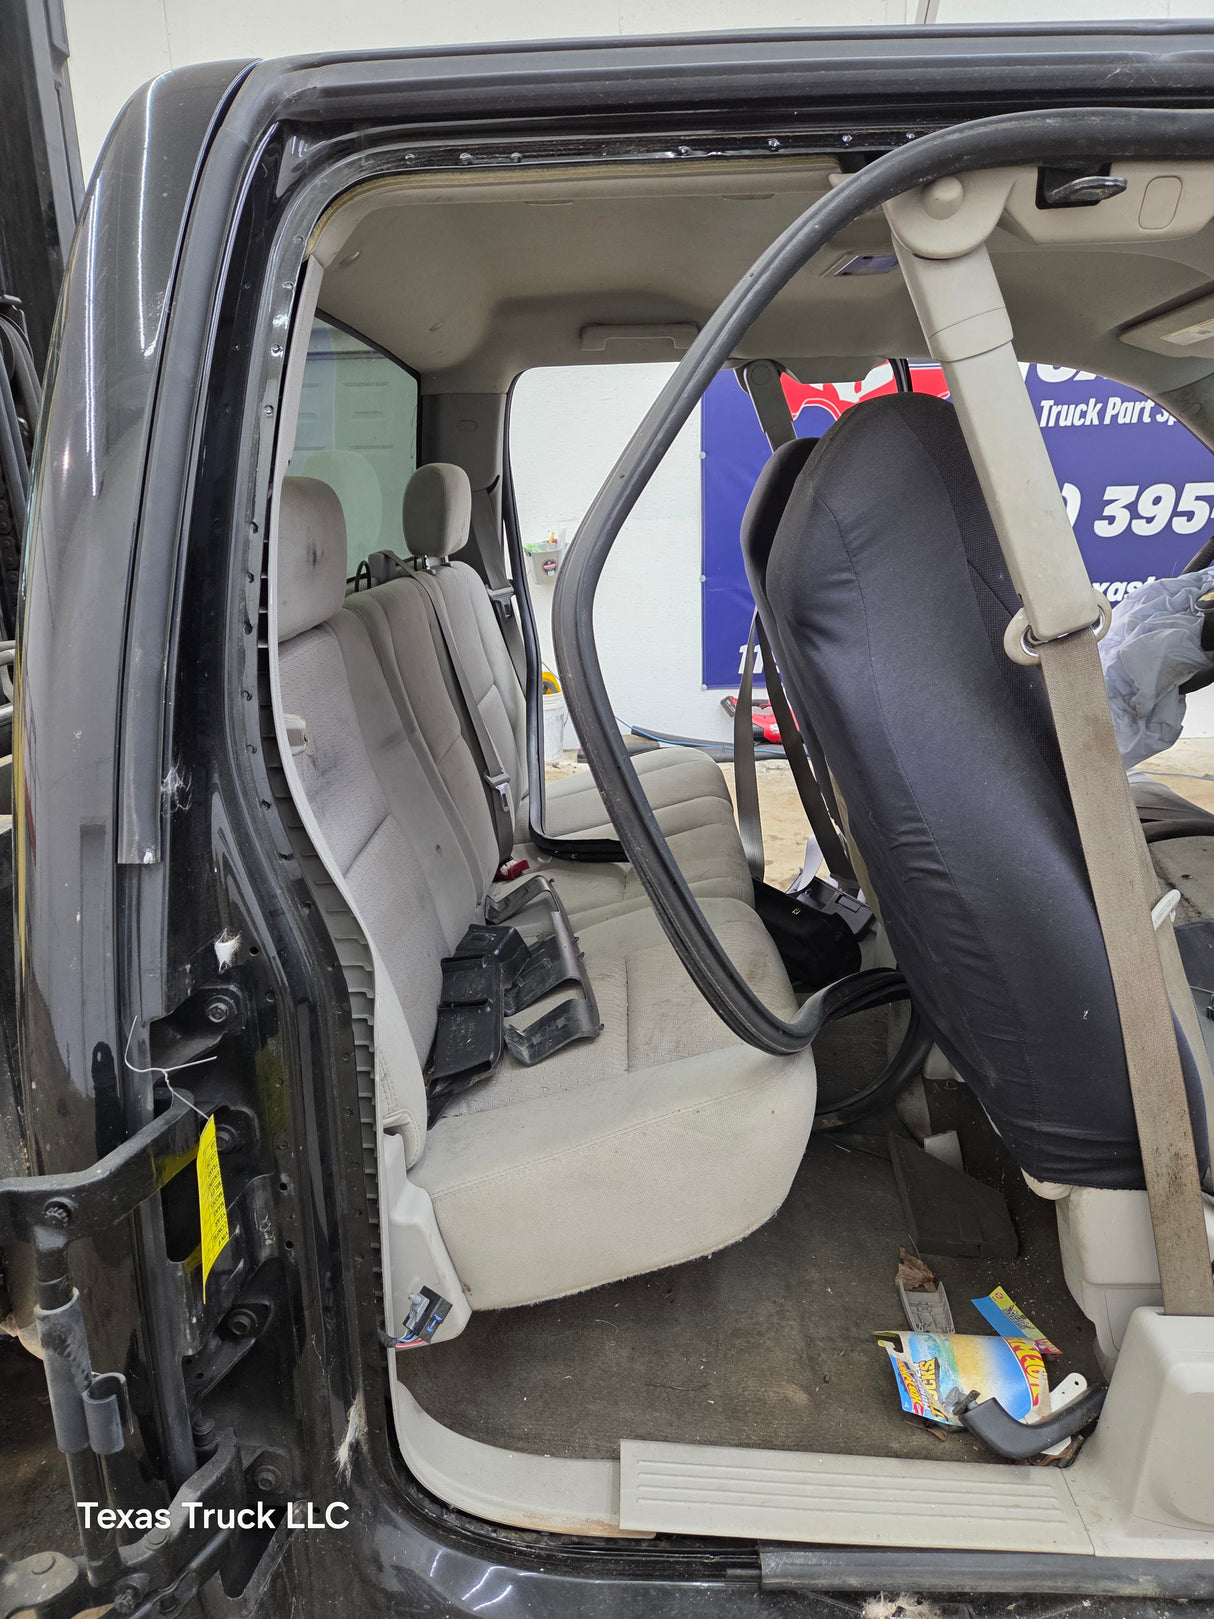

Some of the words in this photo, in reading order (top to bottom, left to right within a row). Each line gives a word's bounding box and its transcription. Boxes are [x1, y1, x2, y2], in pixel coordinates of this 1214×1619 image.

[1039, 397, 1103, 428] Truck
[1103, 397, 1155, 425] Part
[1093, 482, 1214, 537] 395
